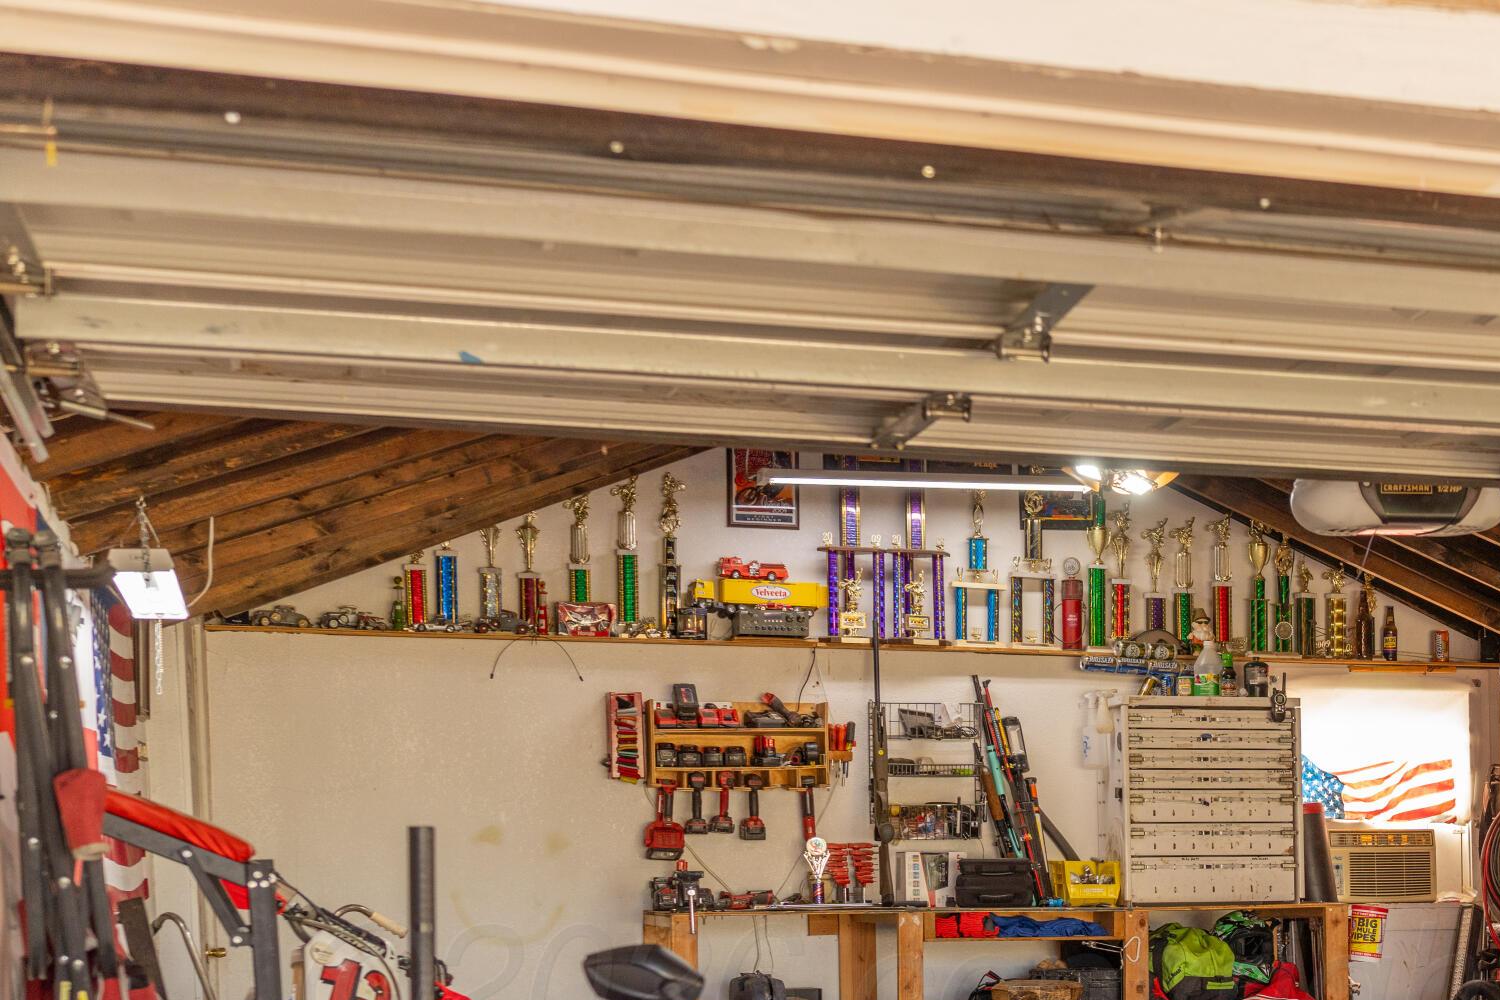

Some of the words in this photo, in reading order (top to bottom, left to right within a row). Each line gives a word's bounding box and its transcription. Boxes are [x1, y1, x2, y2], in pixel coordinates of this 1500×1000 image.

[1383, 483, 1430, 493] CRAFTSMAN
[755, 588, 787, 598] Velveeta
[1357, 918, 1378, 928] BIG
[1356, 926, 1377, 935] MULE
